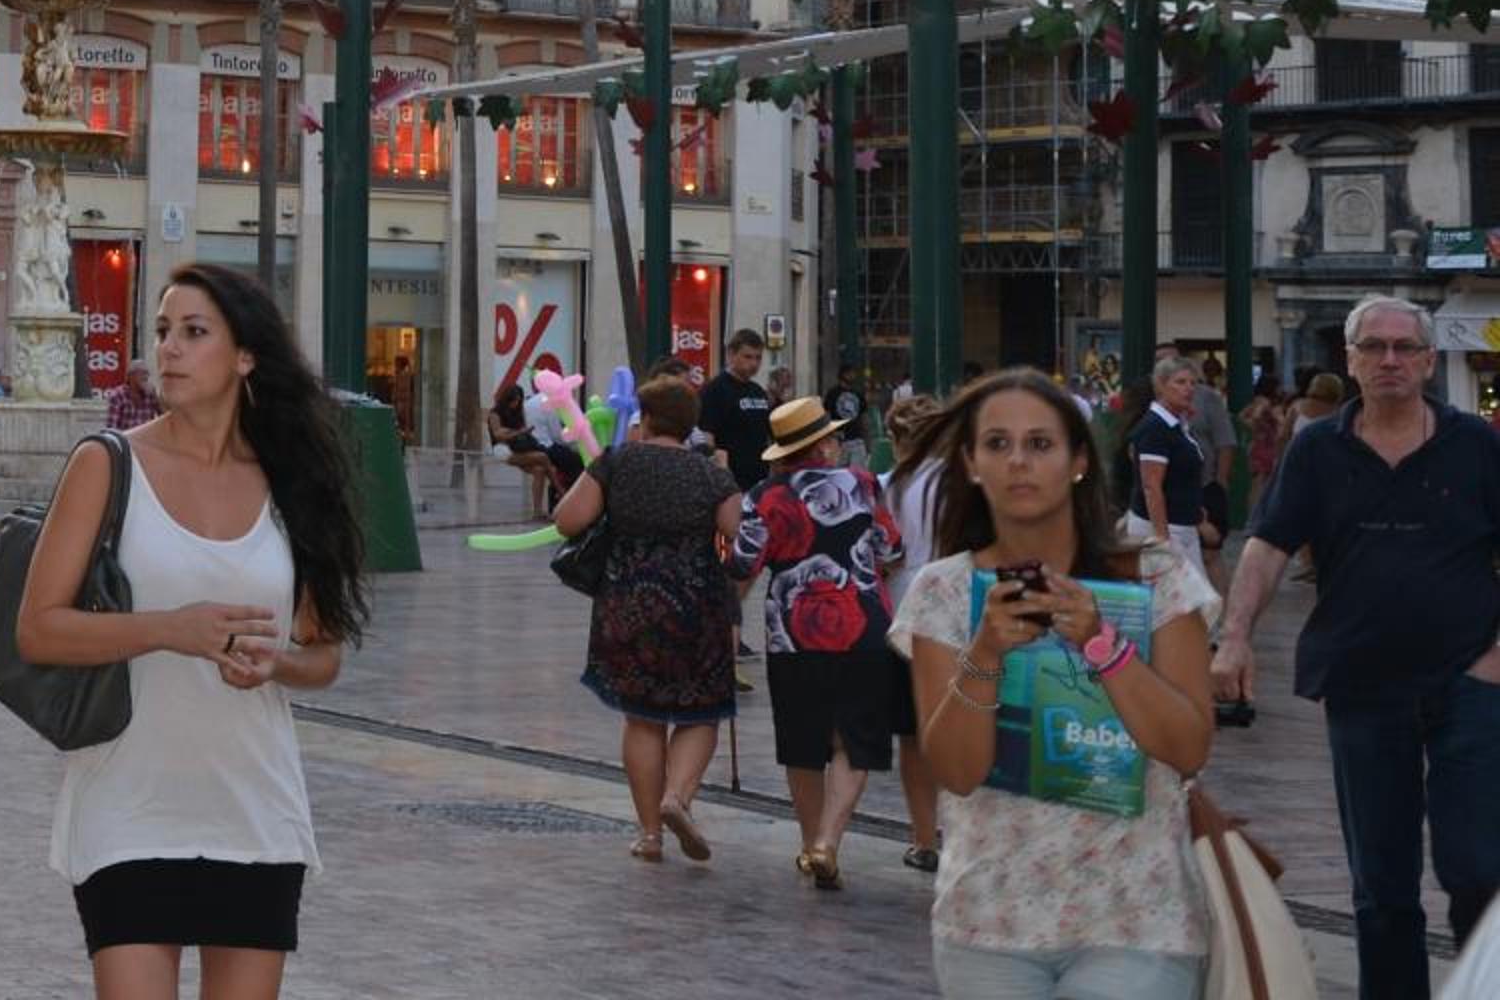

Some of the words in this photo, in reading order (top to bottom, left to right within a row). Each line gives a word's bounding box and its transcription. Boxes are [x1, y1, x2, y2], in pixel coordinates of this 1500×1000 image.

[77, 46, 135, 64] toretto
[211, 53, 289, 74] Tintoreo
[371, 279, 439, 296] NTESIS
[1064, 721, 1137, 750] Babe
